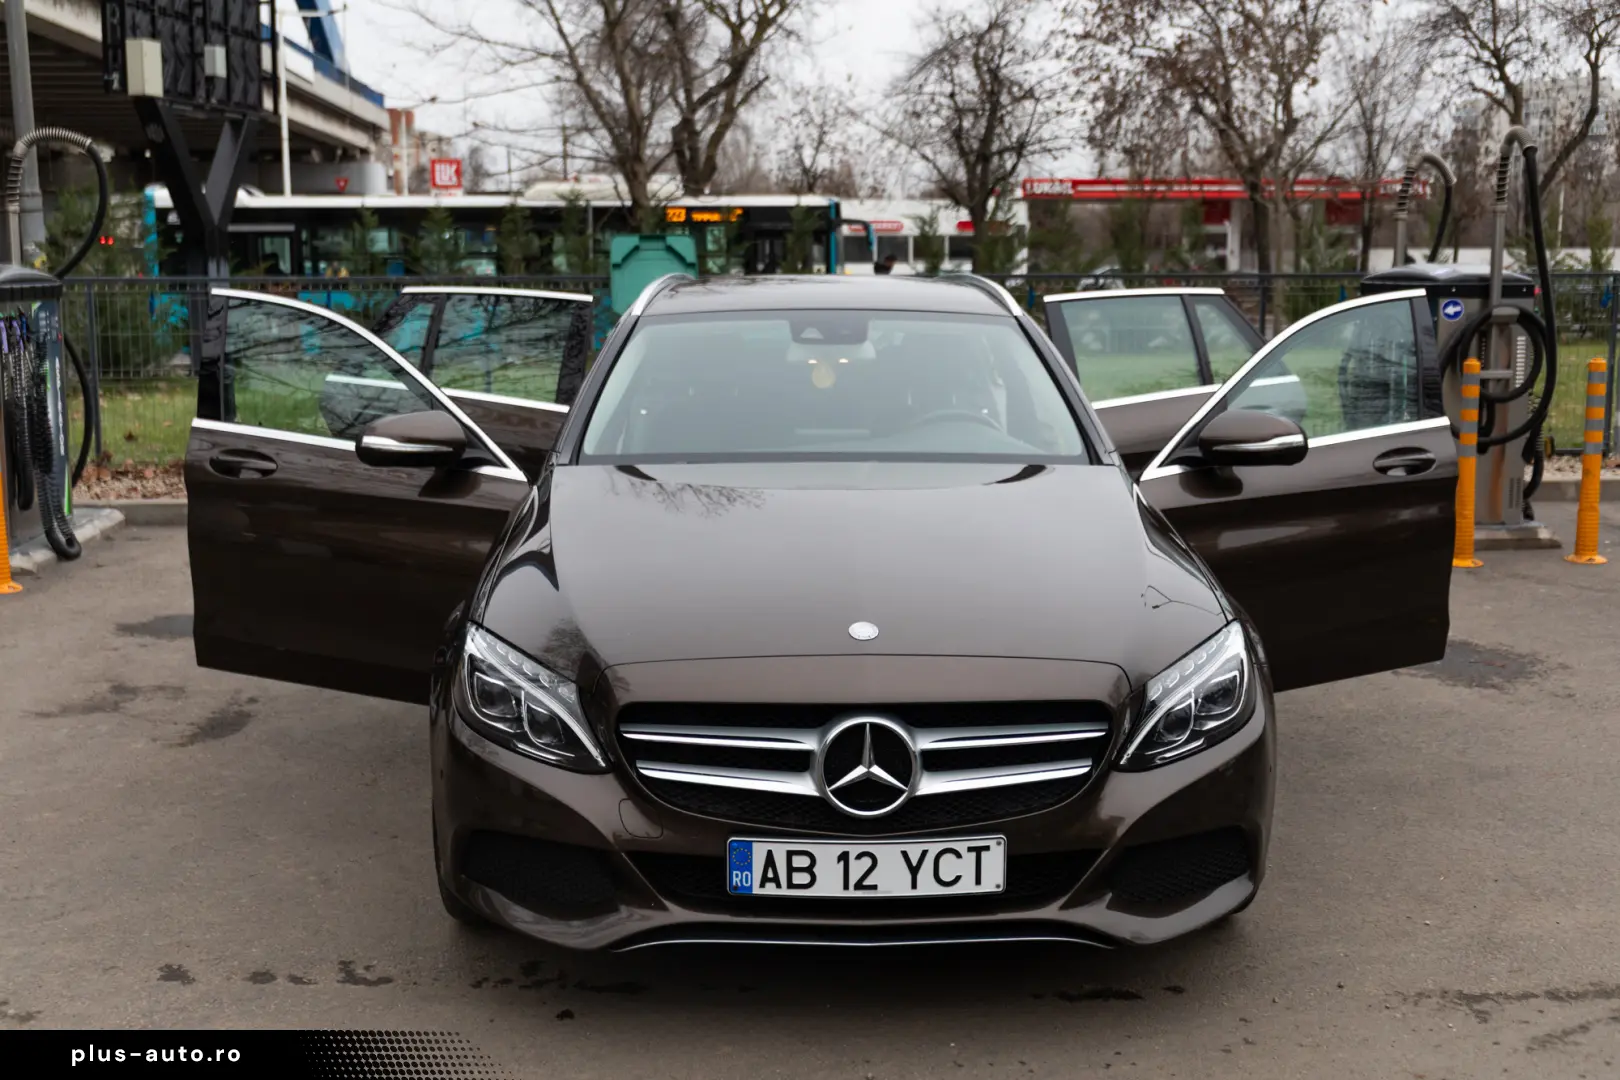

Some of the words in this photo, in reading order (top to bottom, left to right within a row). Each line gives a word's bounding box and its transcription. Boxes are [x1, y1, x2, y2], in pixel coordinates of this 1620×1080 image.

[732, 870, 751, 887] RO
[758, 849, 817, 889] AB
[836, 850, 878, 891] 12
[900, 844, 992, 890] YCT
